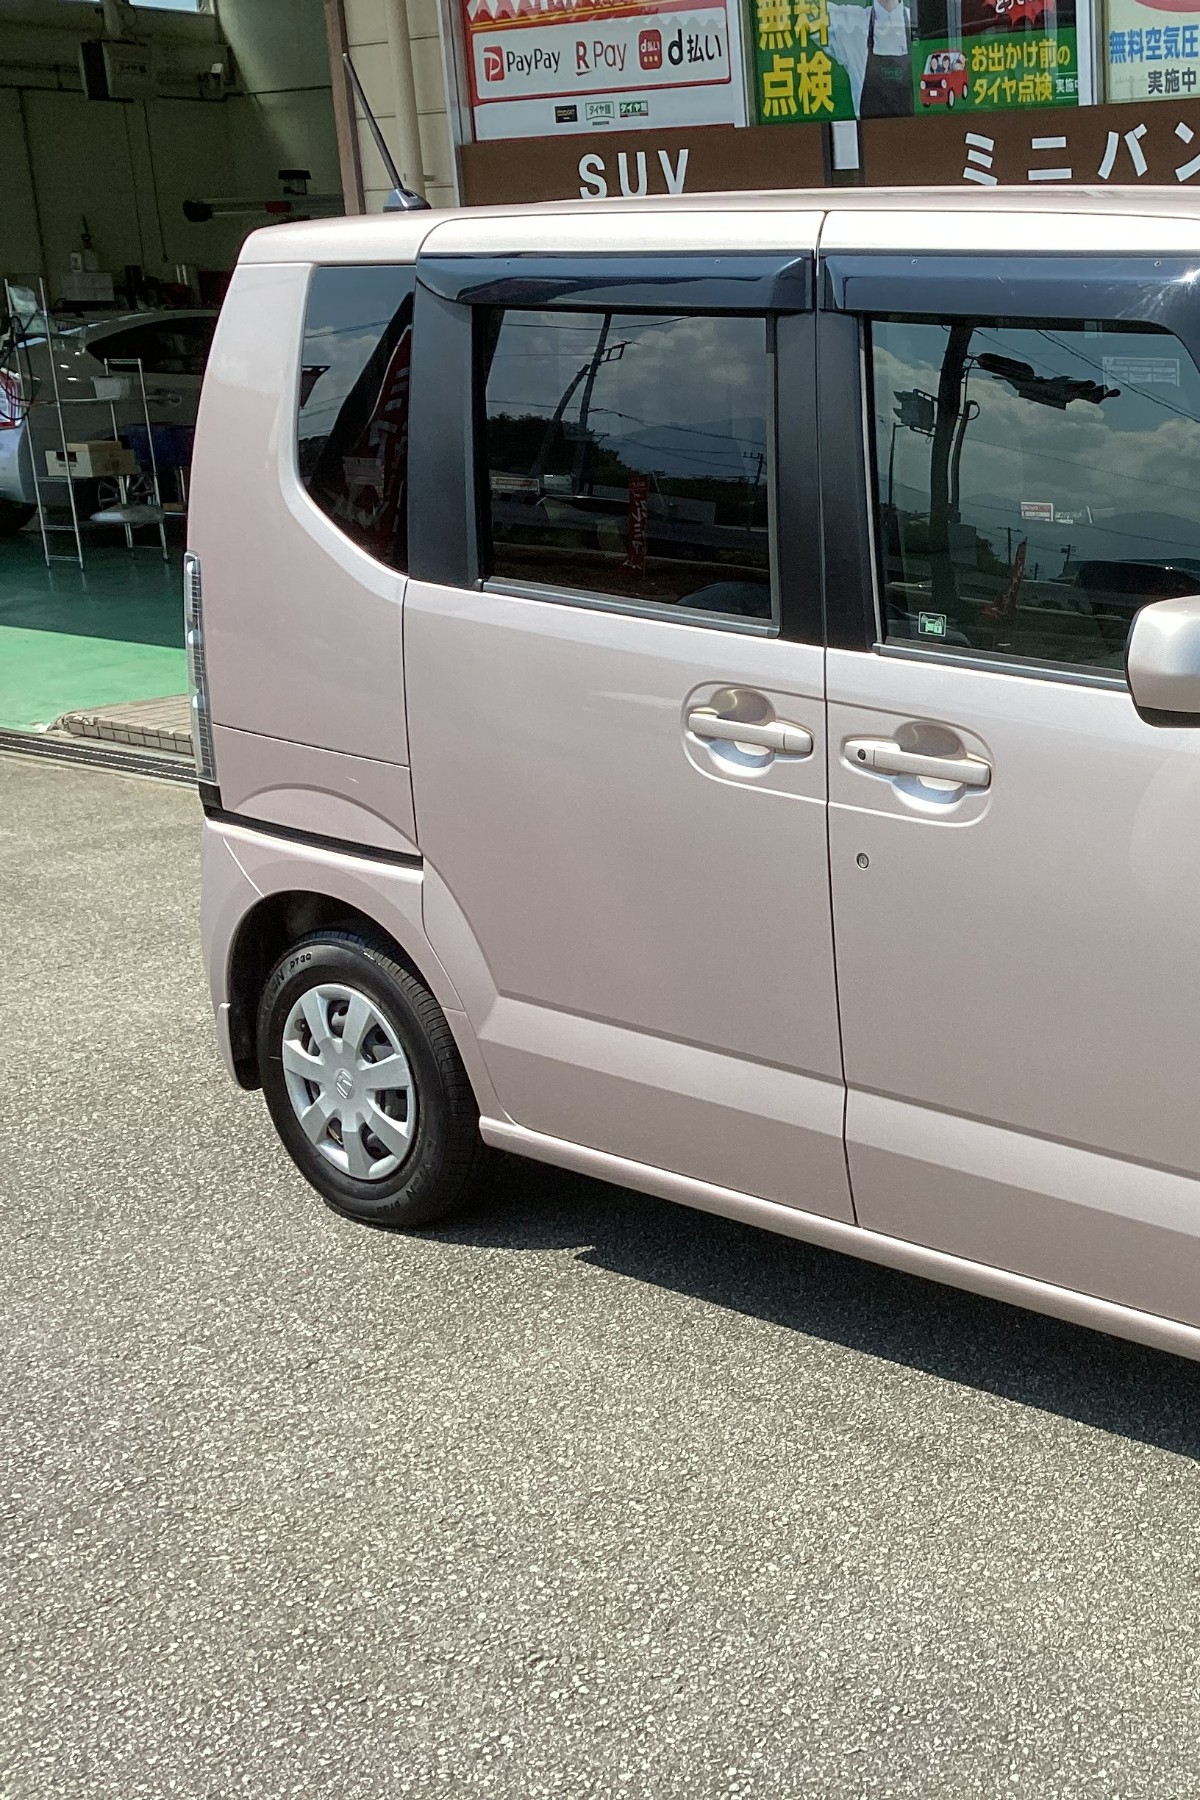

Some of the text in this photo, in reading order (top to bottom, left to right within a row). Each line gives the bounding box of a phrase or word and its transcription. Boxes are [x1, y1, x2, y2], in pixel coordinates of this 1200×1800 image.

[506, 48, 561, 75] PayPay
[594, 40, 627, 71] Pay
[668, 29, 722, 66] d払い
[972, 38, 1070, 72] お出かけ前の
[763, 51, 834, 117] 点検
[973, 72, 1053, 104] タイヤ点検
[1147, 67, 1198, 94] 実施中
[579, 149, 690, 200] SUV
